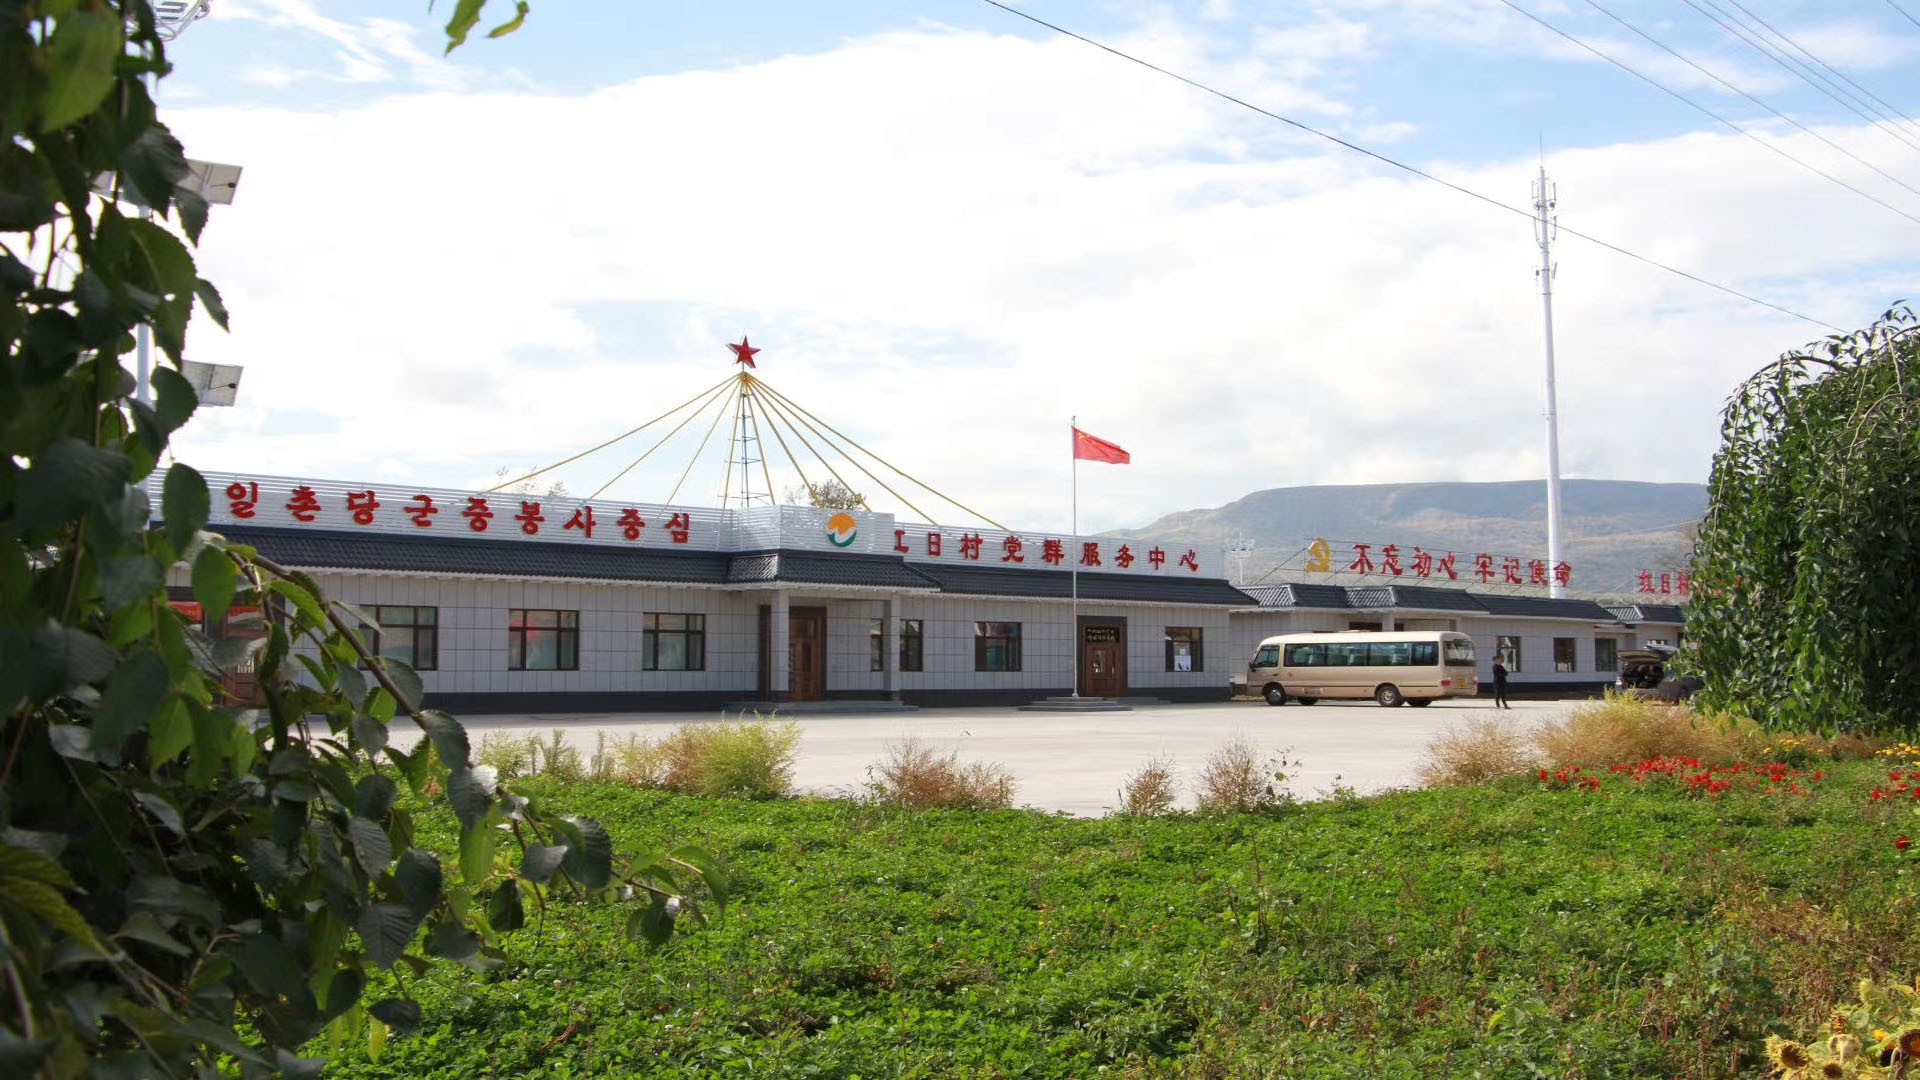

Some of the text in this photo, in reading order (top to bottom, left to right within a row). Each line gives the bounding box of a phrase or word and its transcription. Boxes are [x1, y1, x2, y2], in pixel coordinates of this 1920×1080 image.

[1350, 543, 1572, 588] 不忘初心 牢记使命
